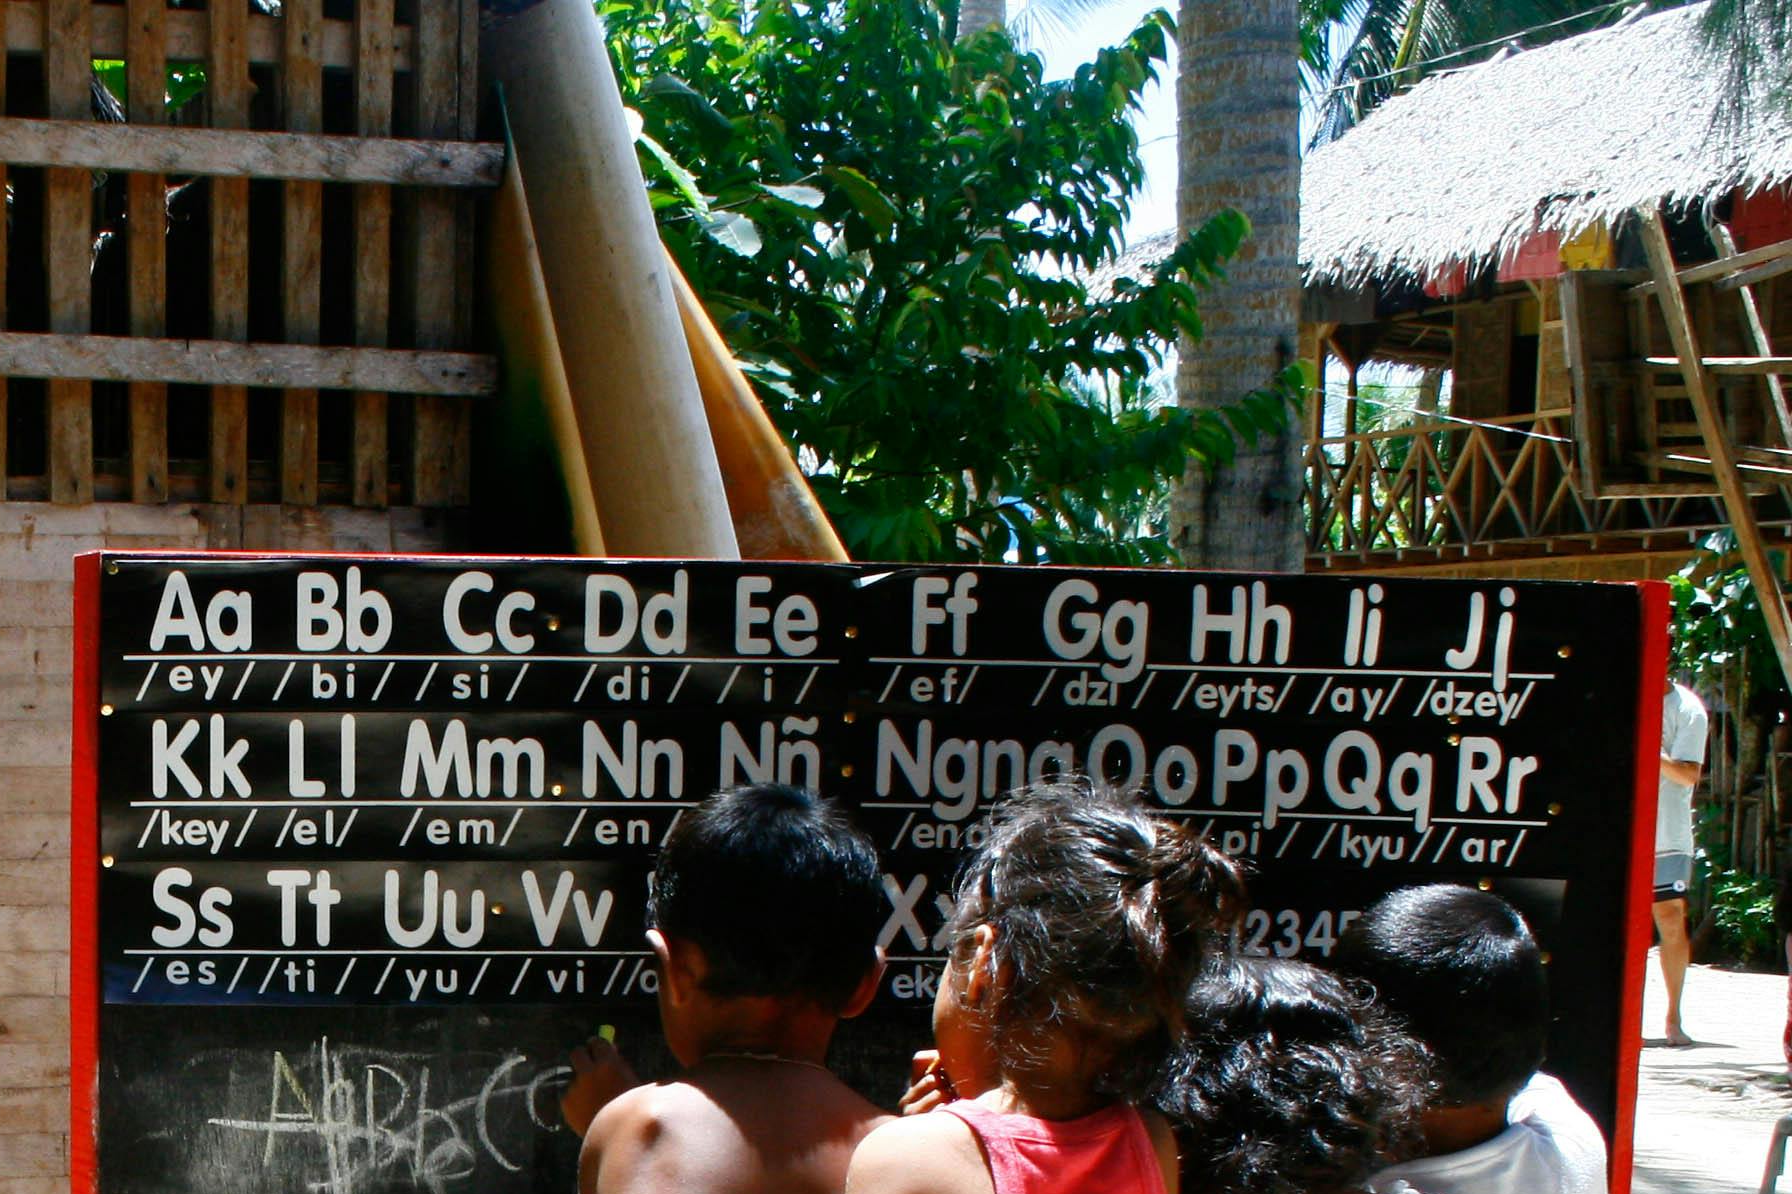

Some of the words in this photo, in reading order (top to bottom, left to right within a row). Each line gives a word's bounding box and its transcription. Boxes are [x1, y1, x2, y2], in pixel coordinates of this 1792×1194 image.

[149, 569, 253, 653] Aa
[296, 565, 393, 654] Bb
[442, 570, 536, 655] Cc
[583, 568, 689, 655] Dd
[735, 576, 819, 657] Ee
[911, 571, 978, 656] Ff
[1042, 578, 1149, 684] Gg
[1189, 580, 1292, 665] Hh
[1344, 583, 1384, 667] Ii
[1444, 586, 1516, 692] Jj
[151, 713, 252, 799] Kk
[288, 712, 357, 799] Ll
[399, 718, 545, 799] Mm
[581, 719, 684, 799] Nn
[720, 716, 820, 794] Nñ
[1087, 724, 1199, 805] Oo
[1213, 729, 1309, 830] Pp
[1324, 729, 1434, 834] Qq
[1455, 736, 1538, 814] Rr
[151, 867, 234, 949] Ss
[266, 868, 342, 947] Tt
[383, 868, 486, 949] Uu
[520, 869, 614, 949] Vv
